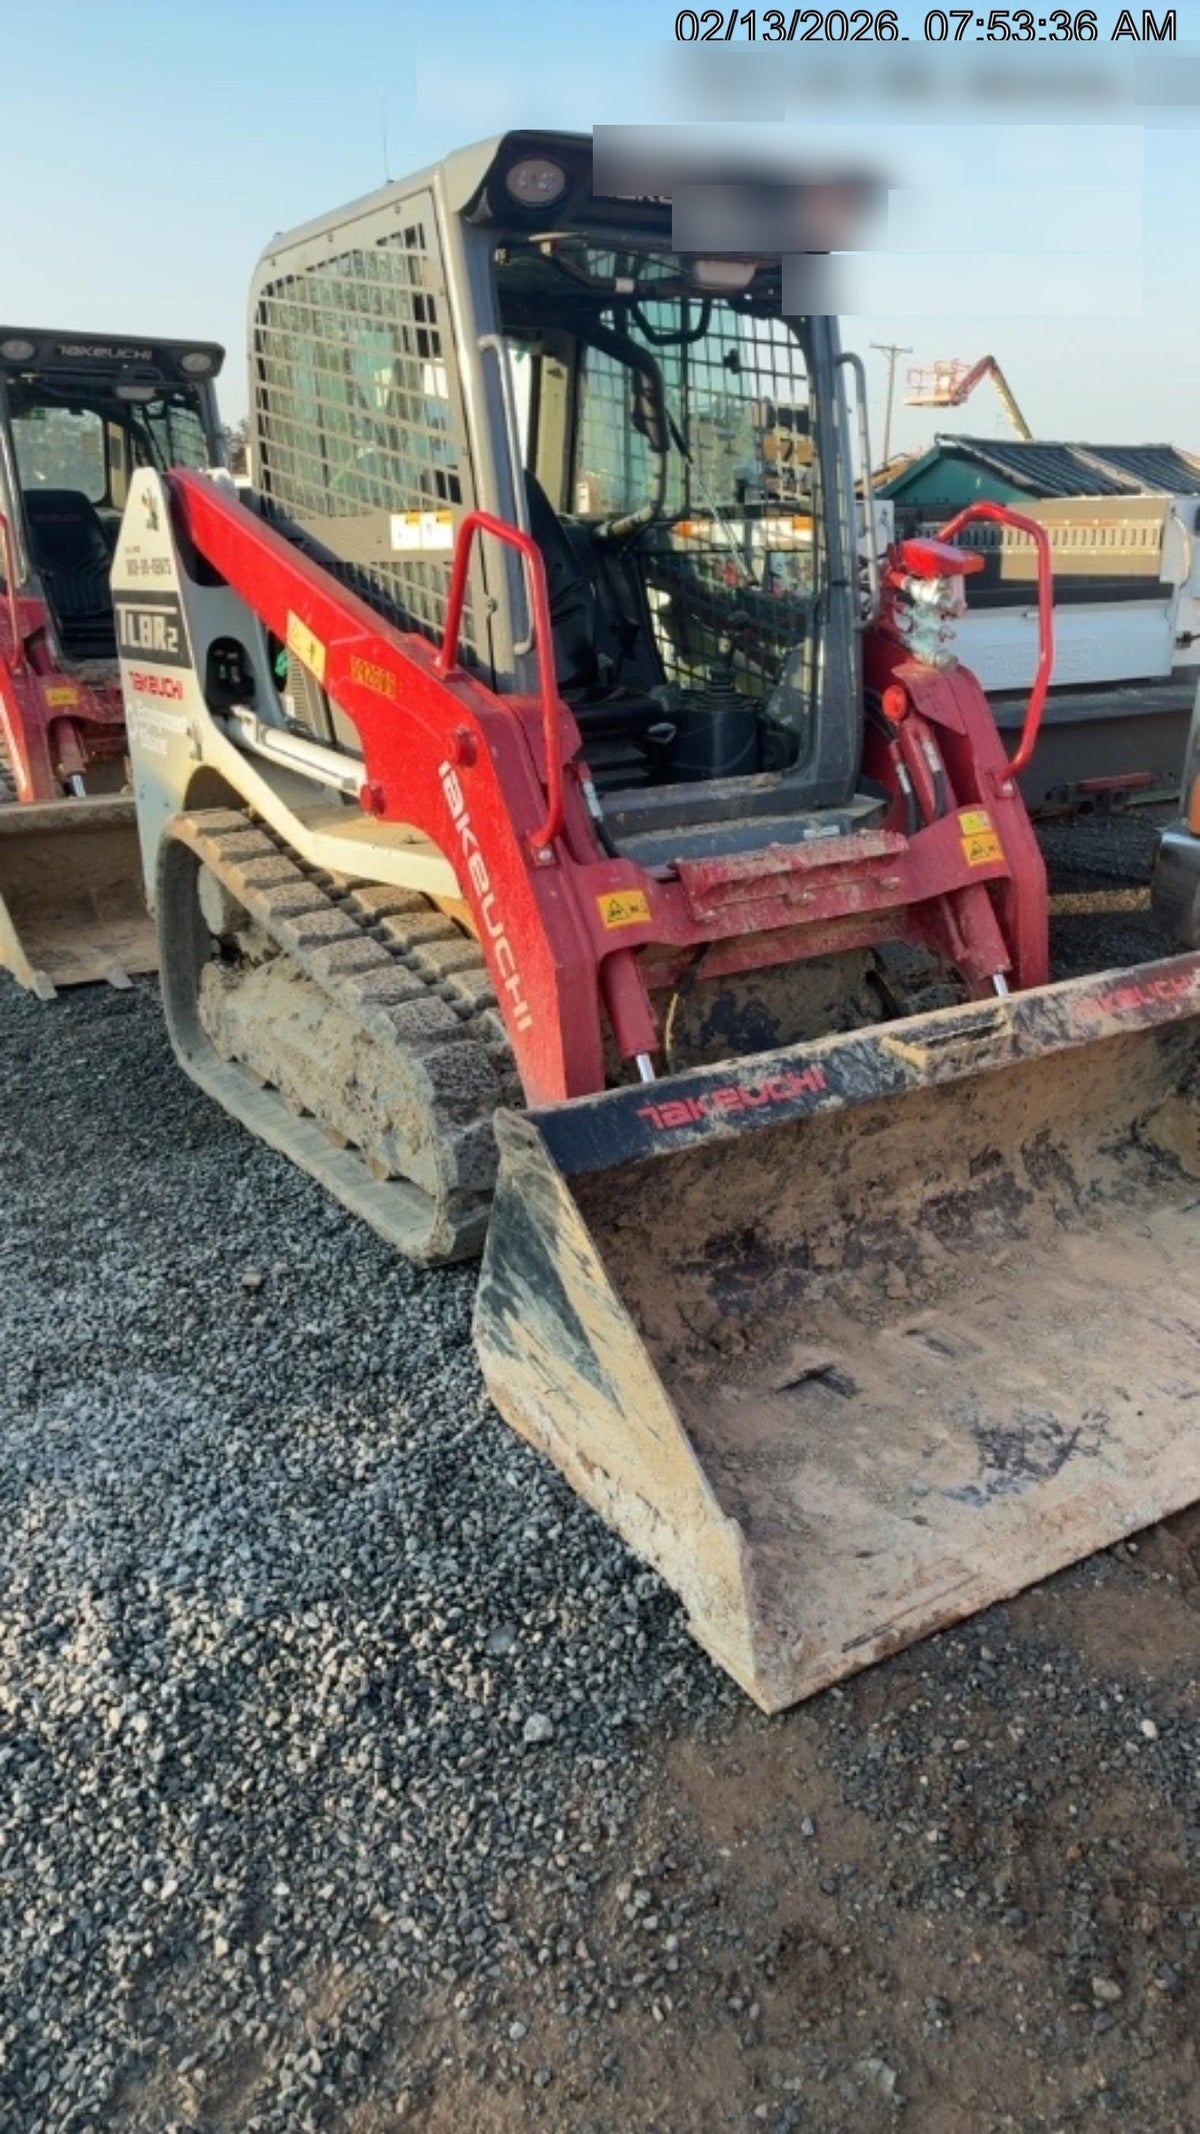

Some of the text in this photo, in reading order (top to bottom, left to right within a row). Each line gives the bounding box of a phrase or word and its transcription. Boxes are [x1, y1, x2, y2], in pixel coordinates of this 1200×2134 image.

[58, 345, 152, 361] TAKEUCHI
[129, 669, 186, 701] TAKEUCHI
[438, 760, 533, 1033] TAKEUCHI
[1072, 976, 1193, 1022] KEUCHI
[637, 1065, 828, 1131] TAKEUCHI
